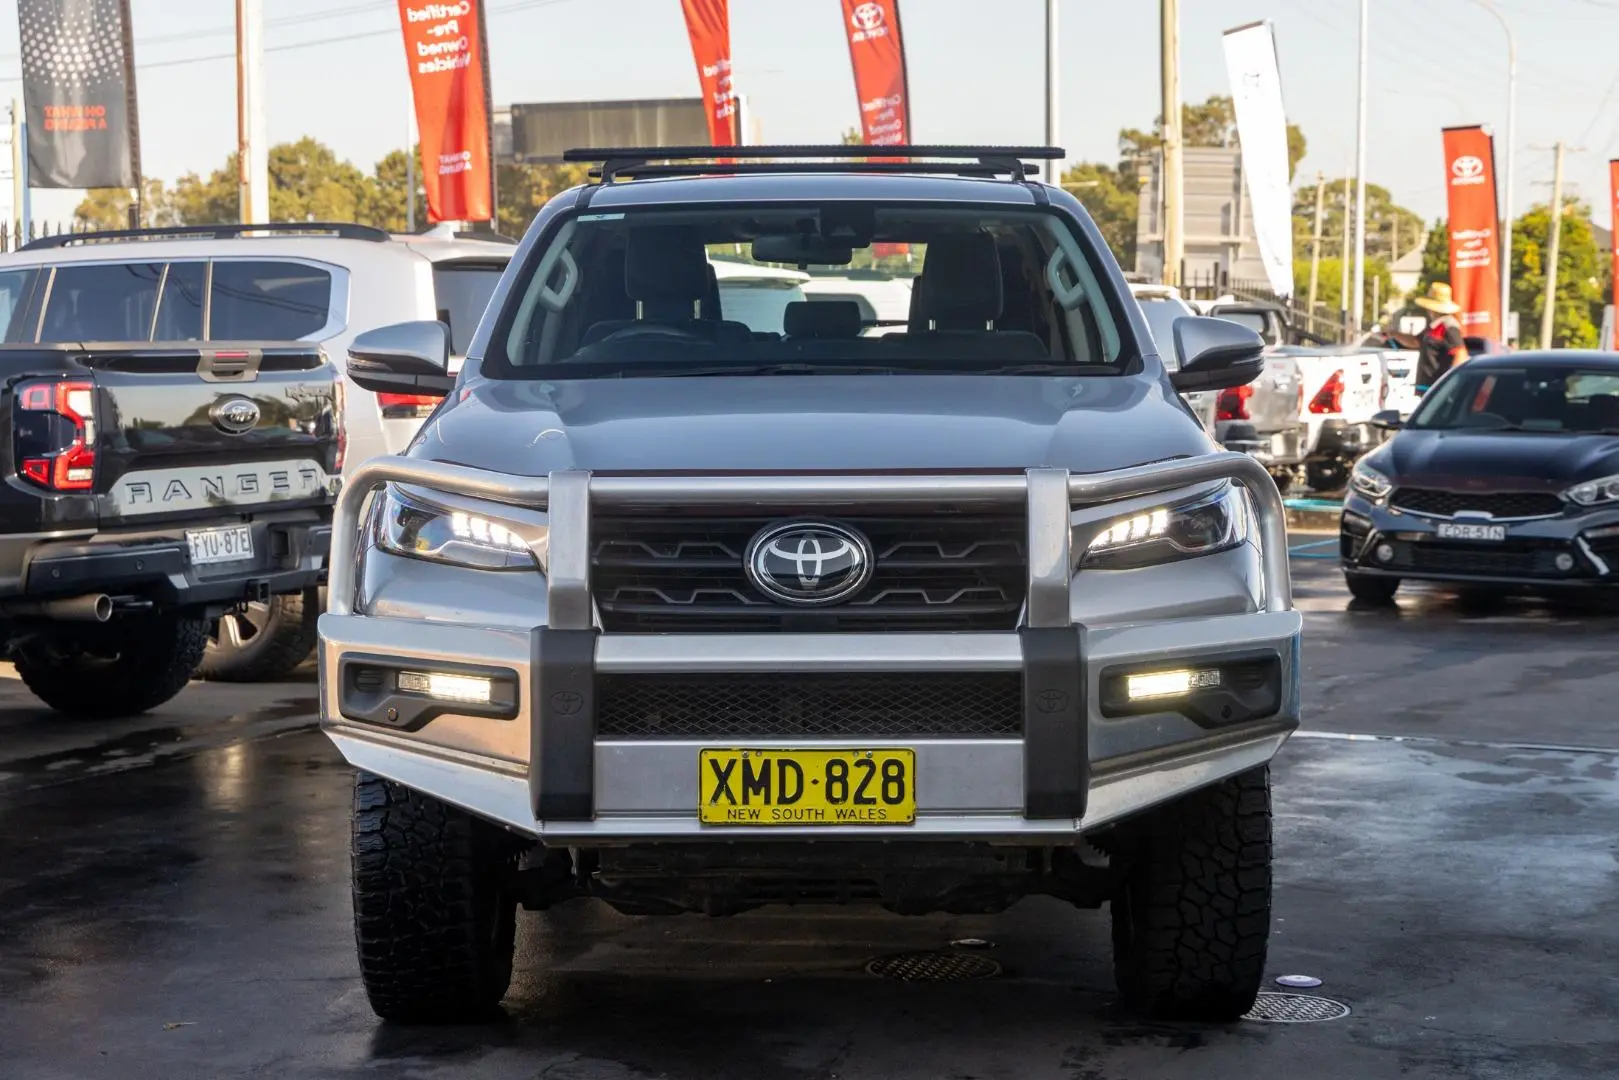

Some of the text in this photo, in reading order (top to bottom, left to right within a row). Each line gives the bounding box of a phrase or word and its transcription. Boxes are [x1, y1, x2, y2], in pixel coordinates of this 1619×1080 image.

[125, 468, 321, 504] RANGER
[727, 809, 887, 820] NEW SOUTH WALES
